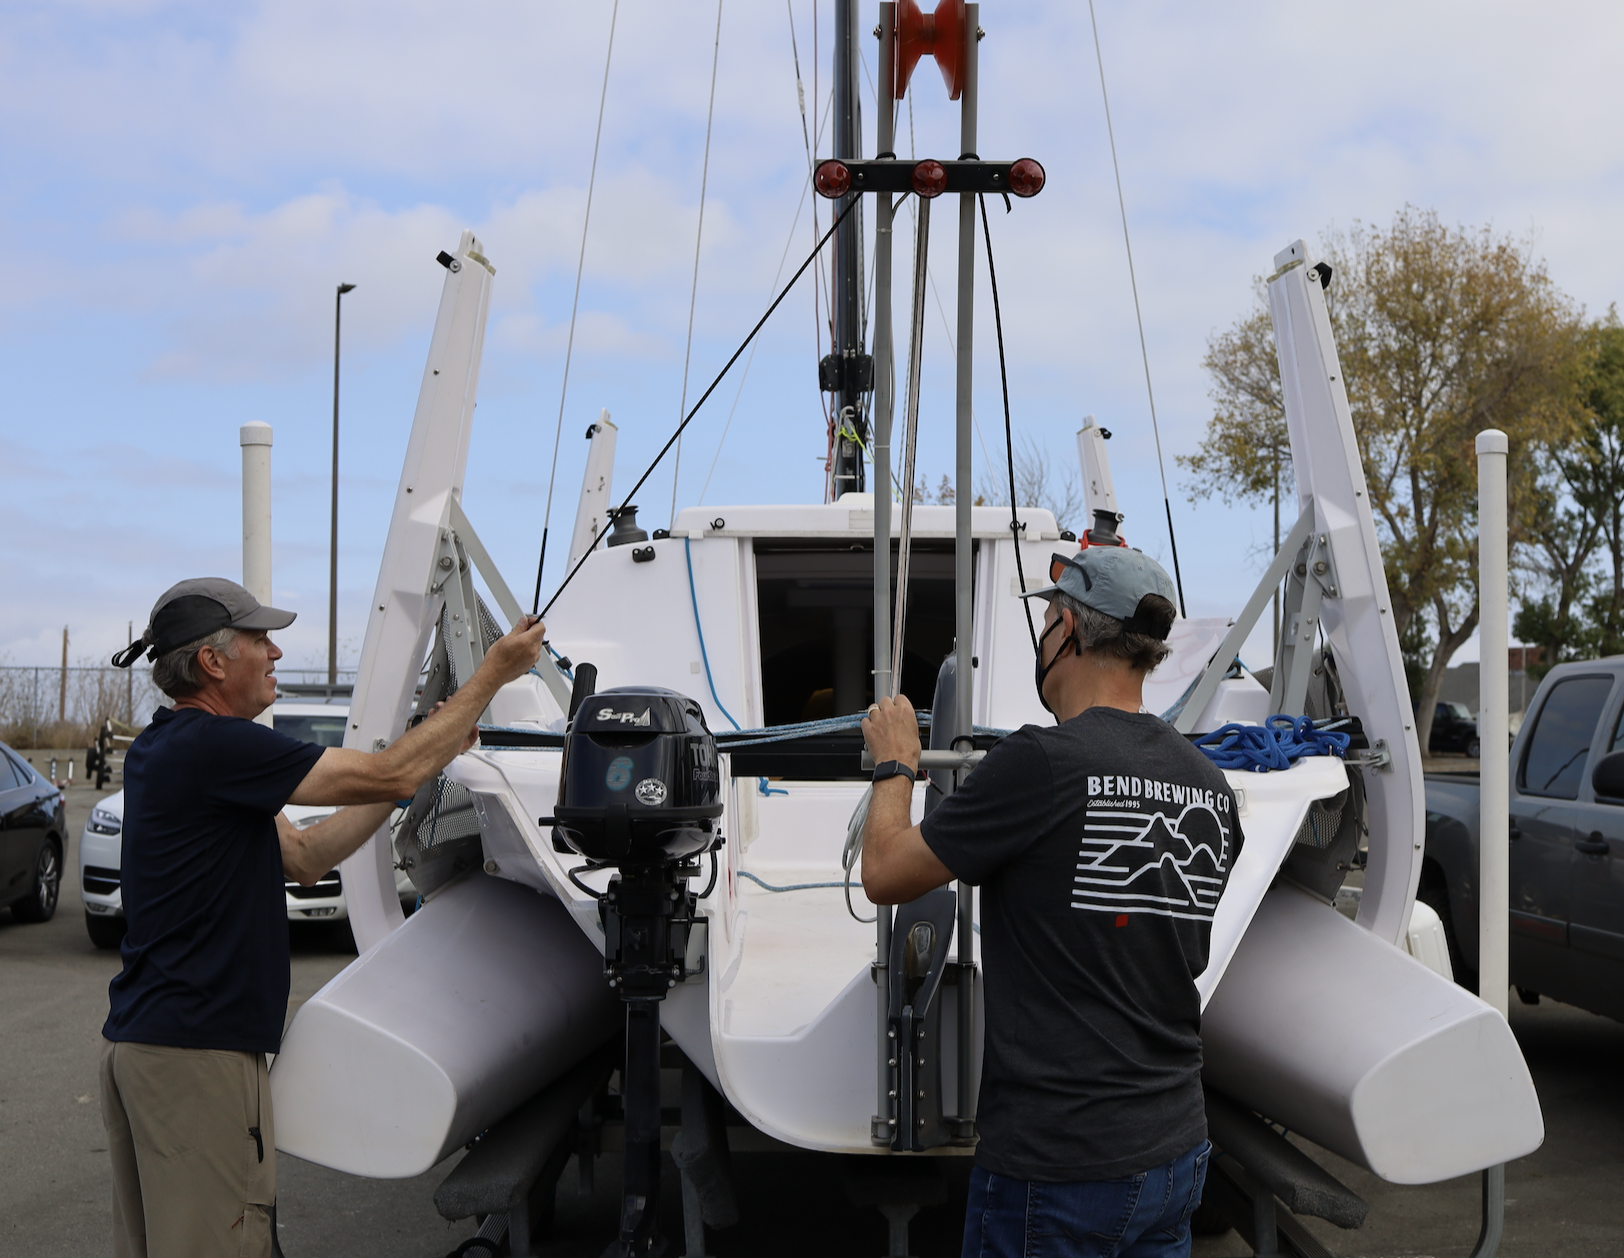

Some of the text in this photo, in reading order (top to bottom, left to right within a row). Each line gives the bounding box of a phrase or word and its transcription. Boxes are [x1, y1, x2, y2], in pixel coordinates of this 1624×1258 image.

[605, 756, 634, 791] 6
[1086, 799, 1141, 809] Established 1995
[1087, 775, 1230, 814] BEND BREWING CO
